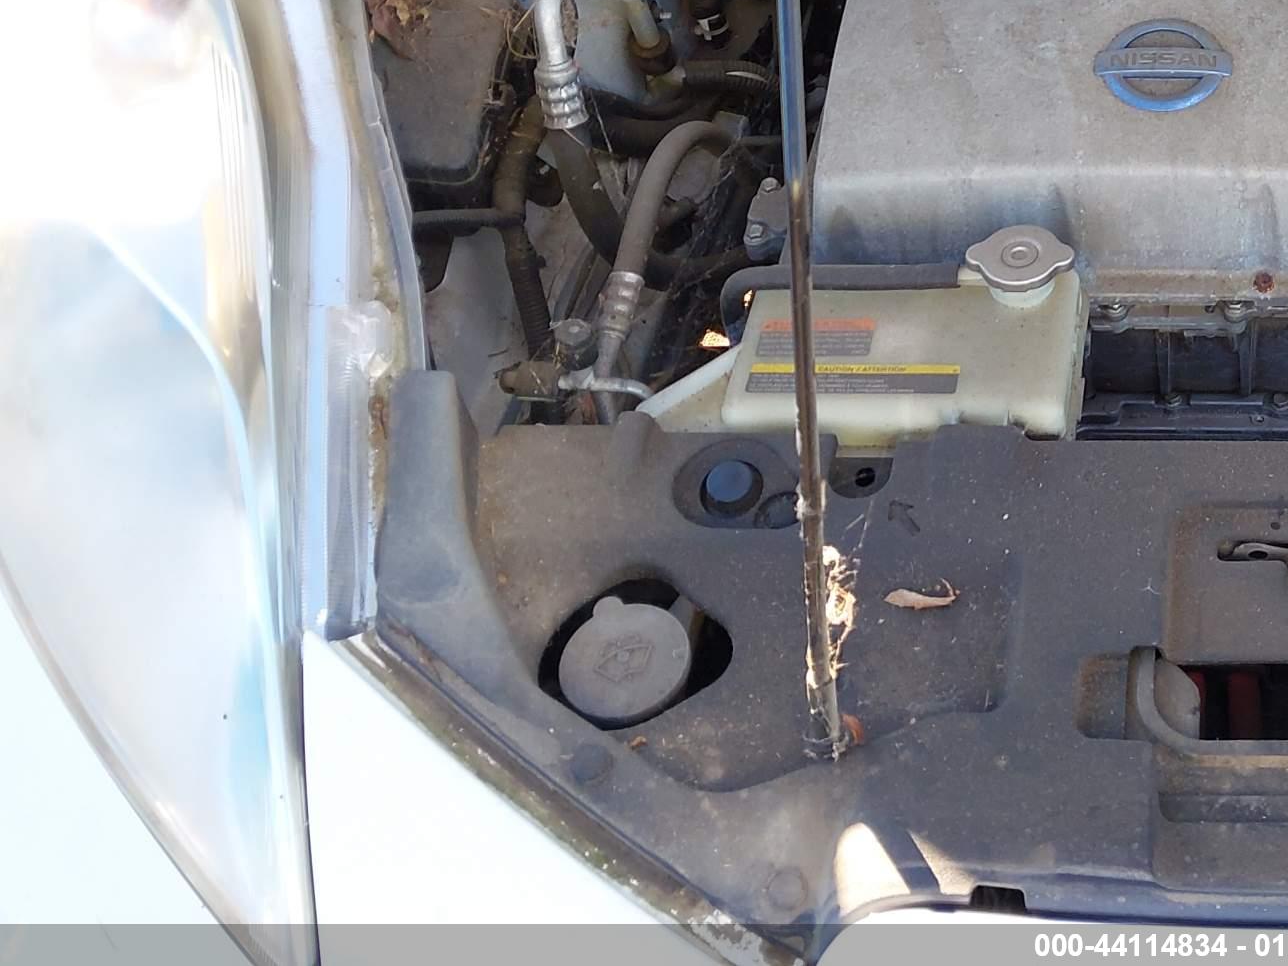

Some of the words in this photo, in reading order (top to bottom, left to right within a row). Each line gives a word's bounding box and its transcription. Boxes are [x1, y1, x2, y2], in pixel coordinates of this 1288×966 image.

[1110, 51, 1217, 67] NISSAN
[818, 364, 854, 373] CAUTION
[862, 365, 907, 373] ATTENTION
